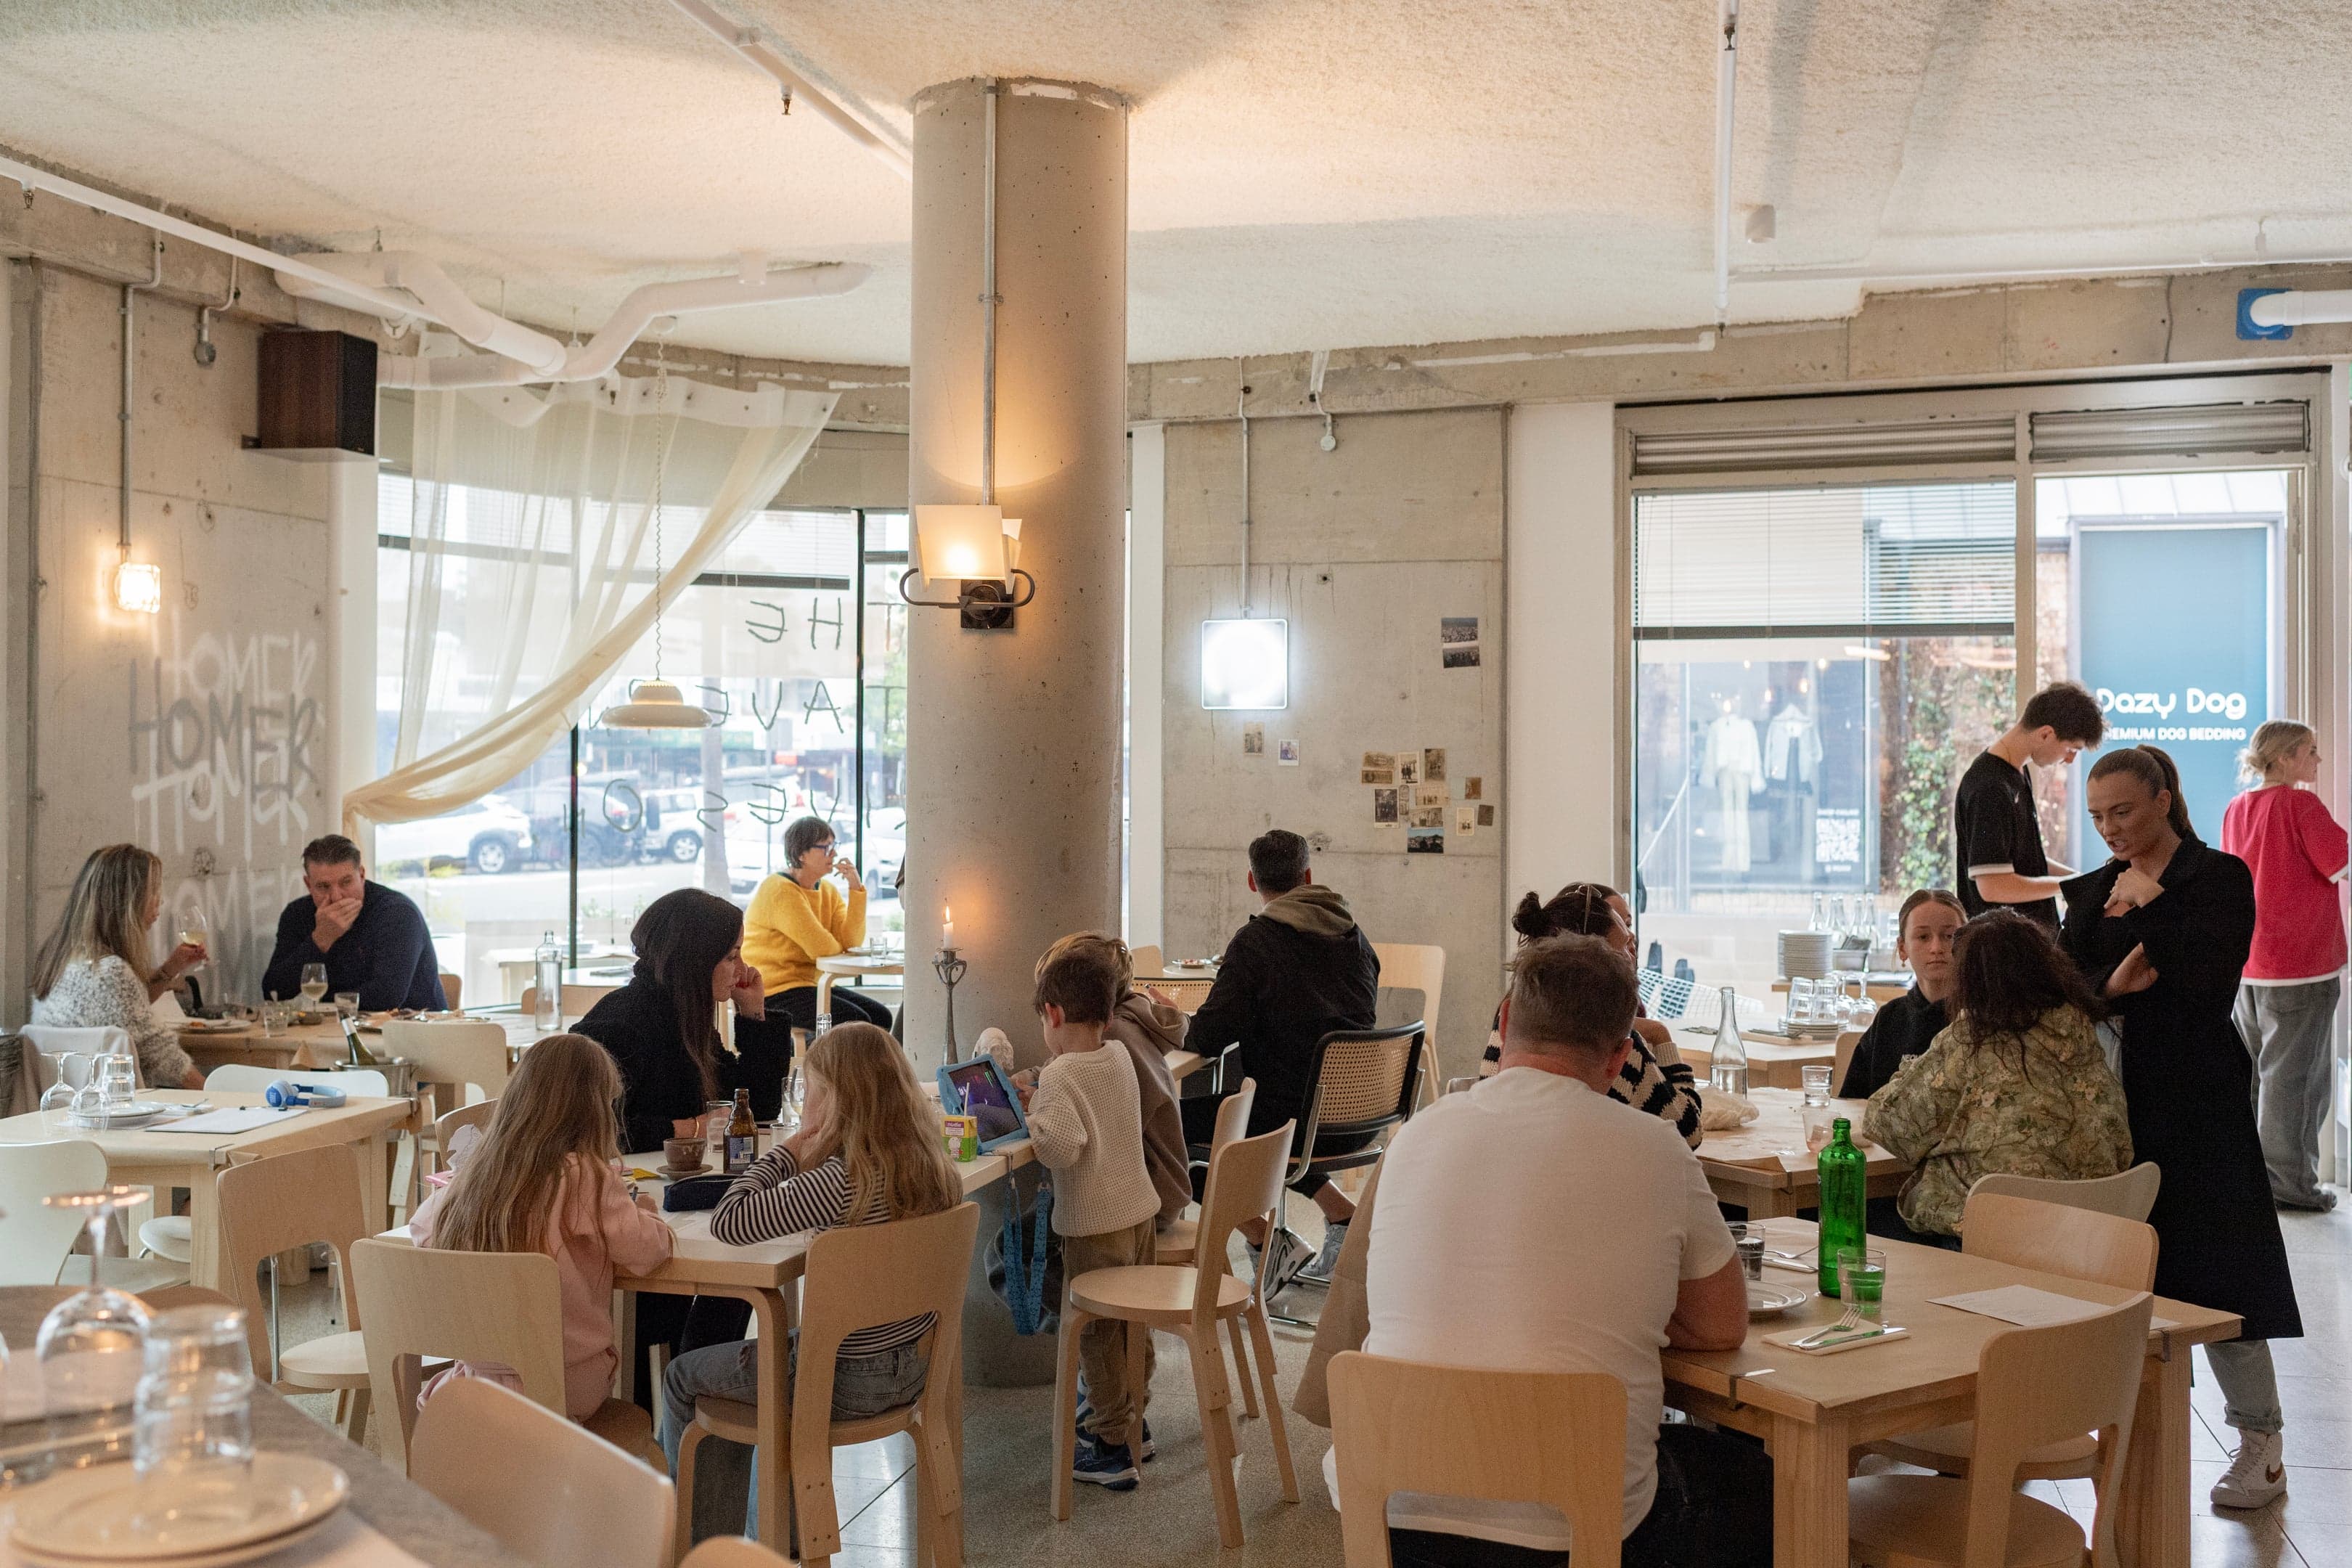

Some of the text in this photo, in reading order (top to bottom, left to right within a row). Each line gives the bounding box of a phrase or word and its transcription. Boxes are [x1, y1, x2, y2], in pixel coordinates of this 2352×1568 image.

[2096, 687, 2247, 720] Dazy Dog
[128, 656, 319, 804] HOMER
[2106, 727, 2246, 740] REMIUM DOG BEDDING
